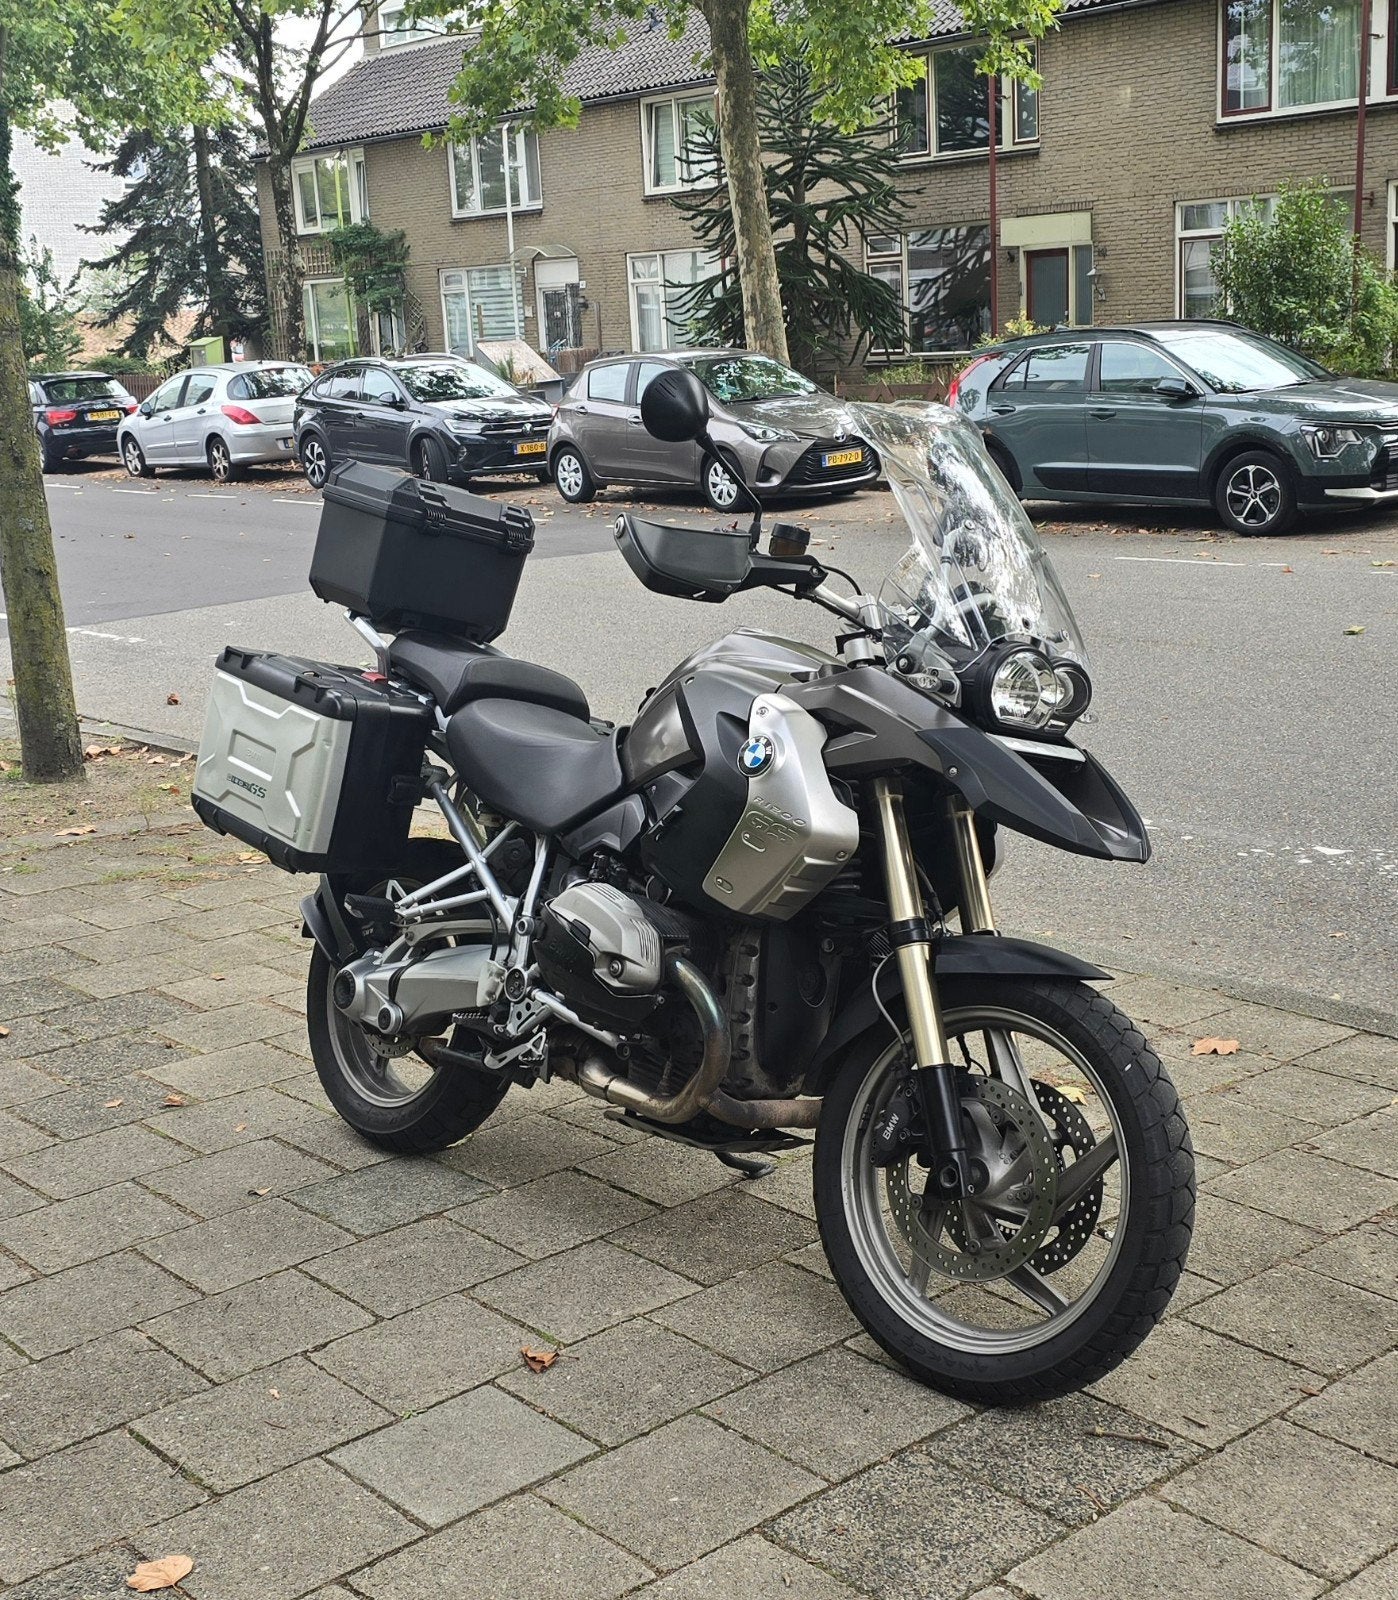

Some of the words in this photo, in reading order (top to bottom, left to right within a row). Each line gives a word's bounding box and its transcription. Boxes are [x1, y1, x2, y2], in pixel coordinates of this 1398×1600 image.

[748, 736, 773, 755] BMW
[753, 796, 807, 827] R1200
[882, 1113, 900, 1140] BMW
